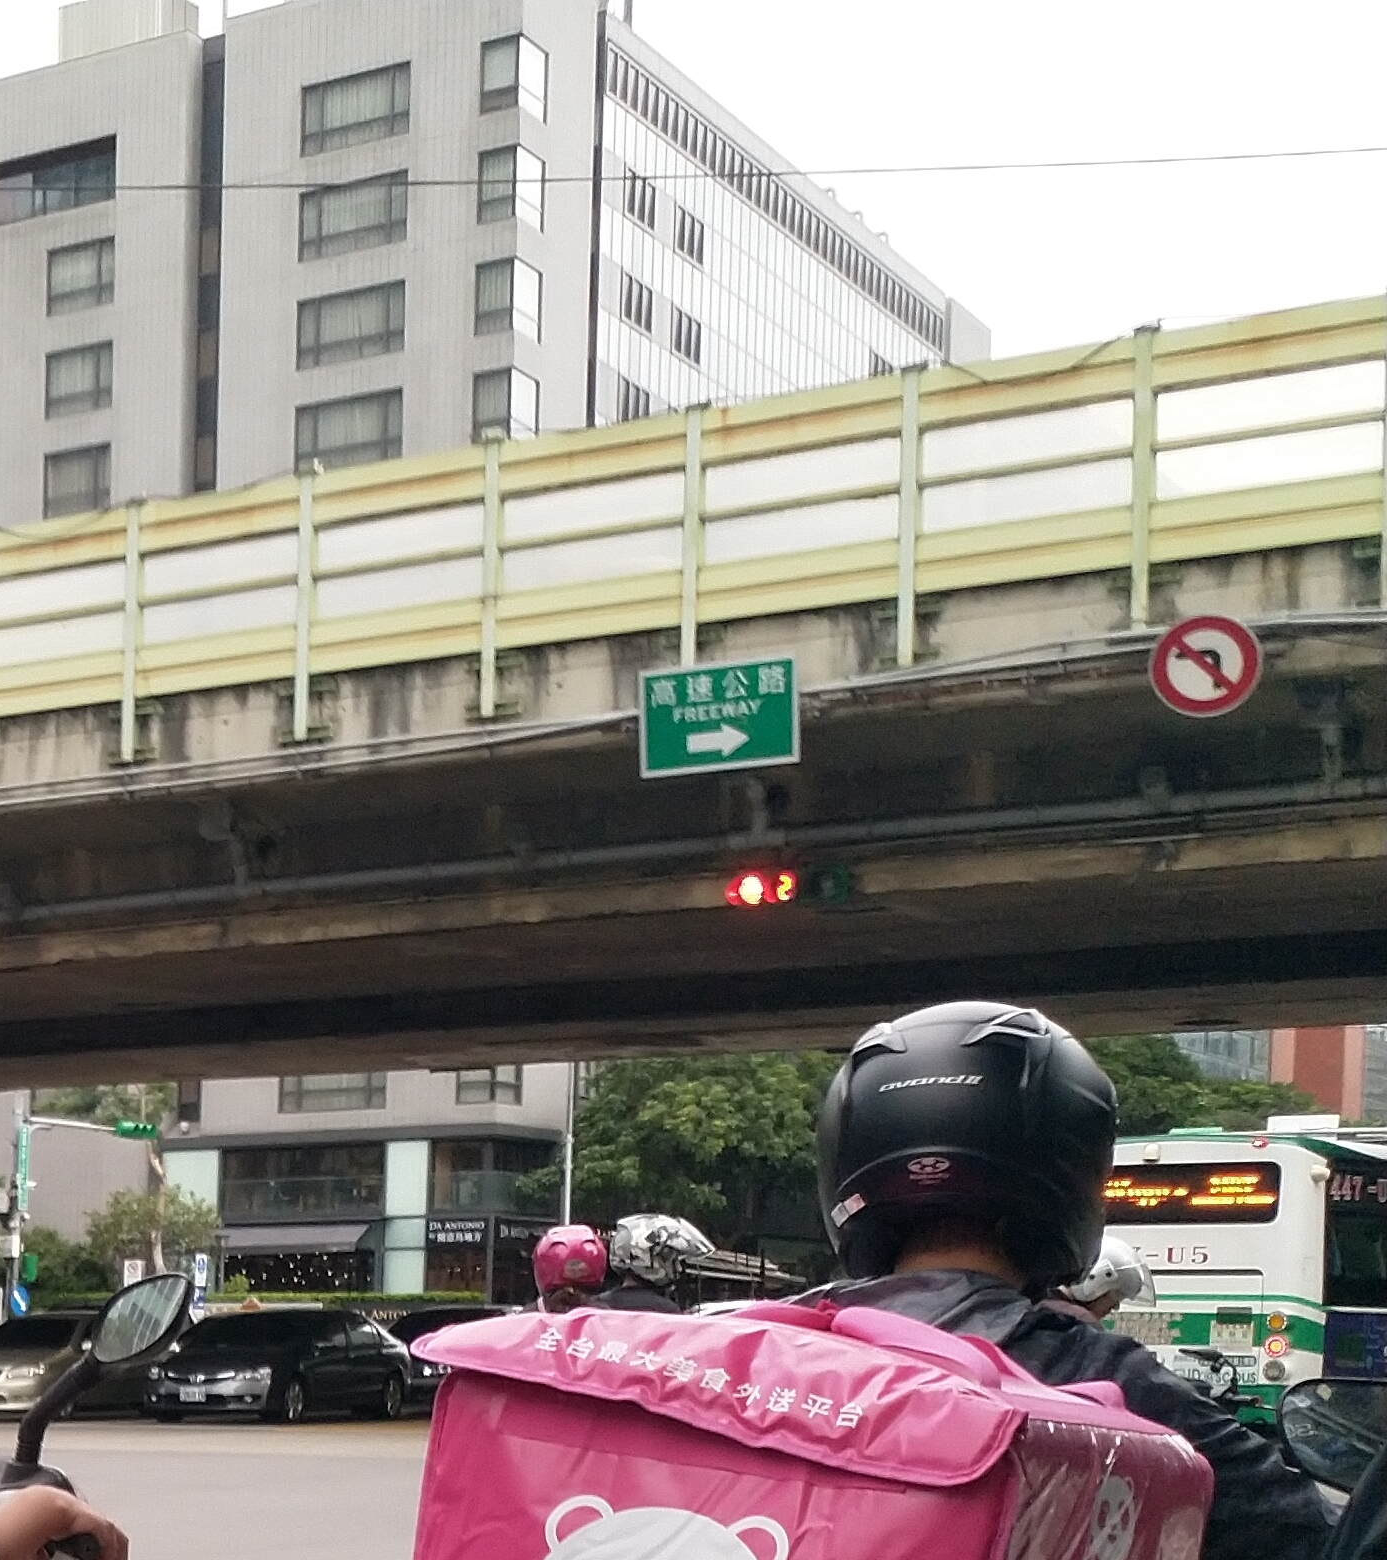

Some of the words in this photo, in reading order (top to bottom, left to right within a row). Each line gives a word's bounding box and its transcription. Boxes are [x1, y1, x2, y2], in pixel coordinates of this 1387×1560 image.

[651, 665, 785, 707] 高速公路
[673, 699, 764, 723] FREEWAY
[1133, 1246, 1209, 1265] -U5
[535, 1326, 864, 1429] 全台最大美食外送平台
